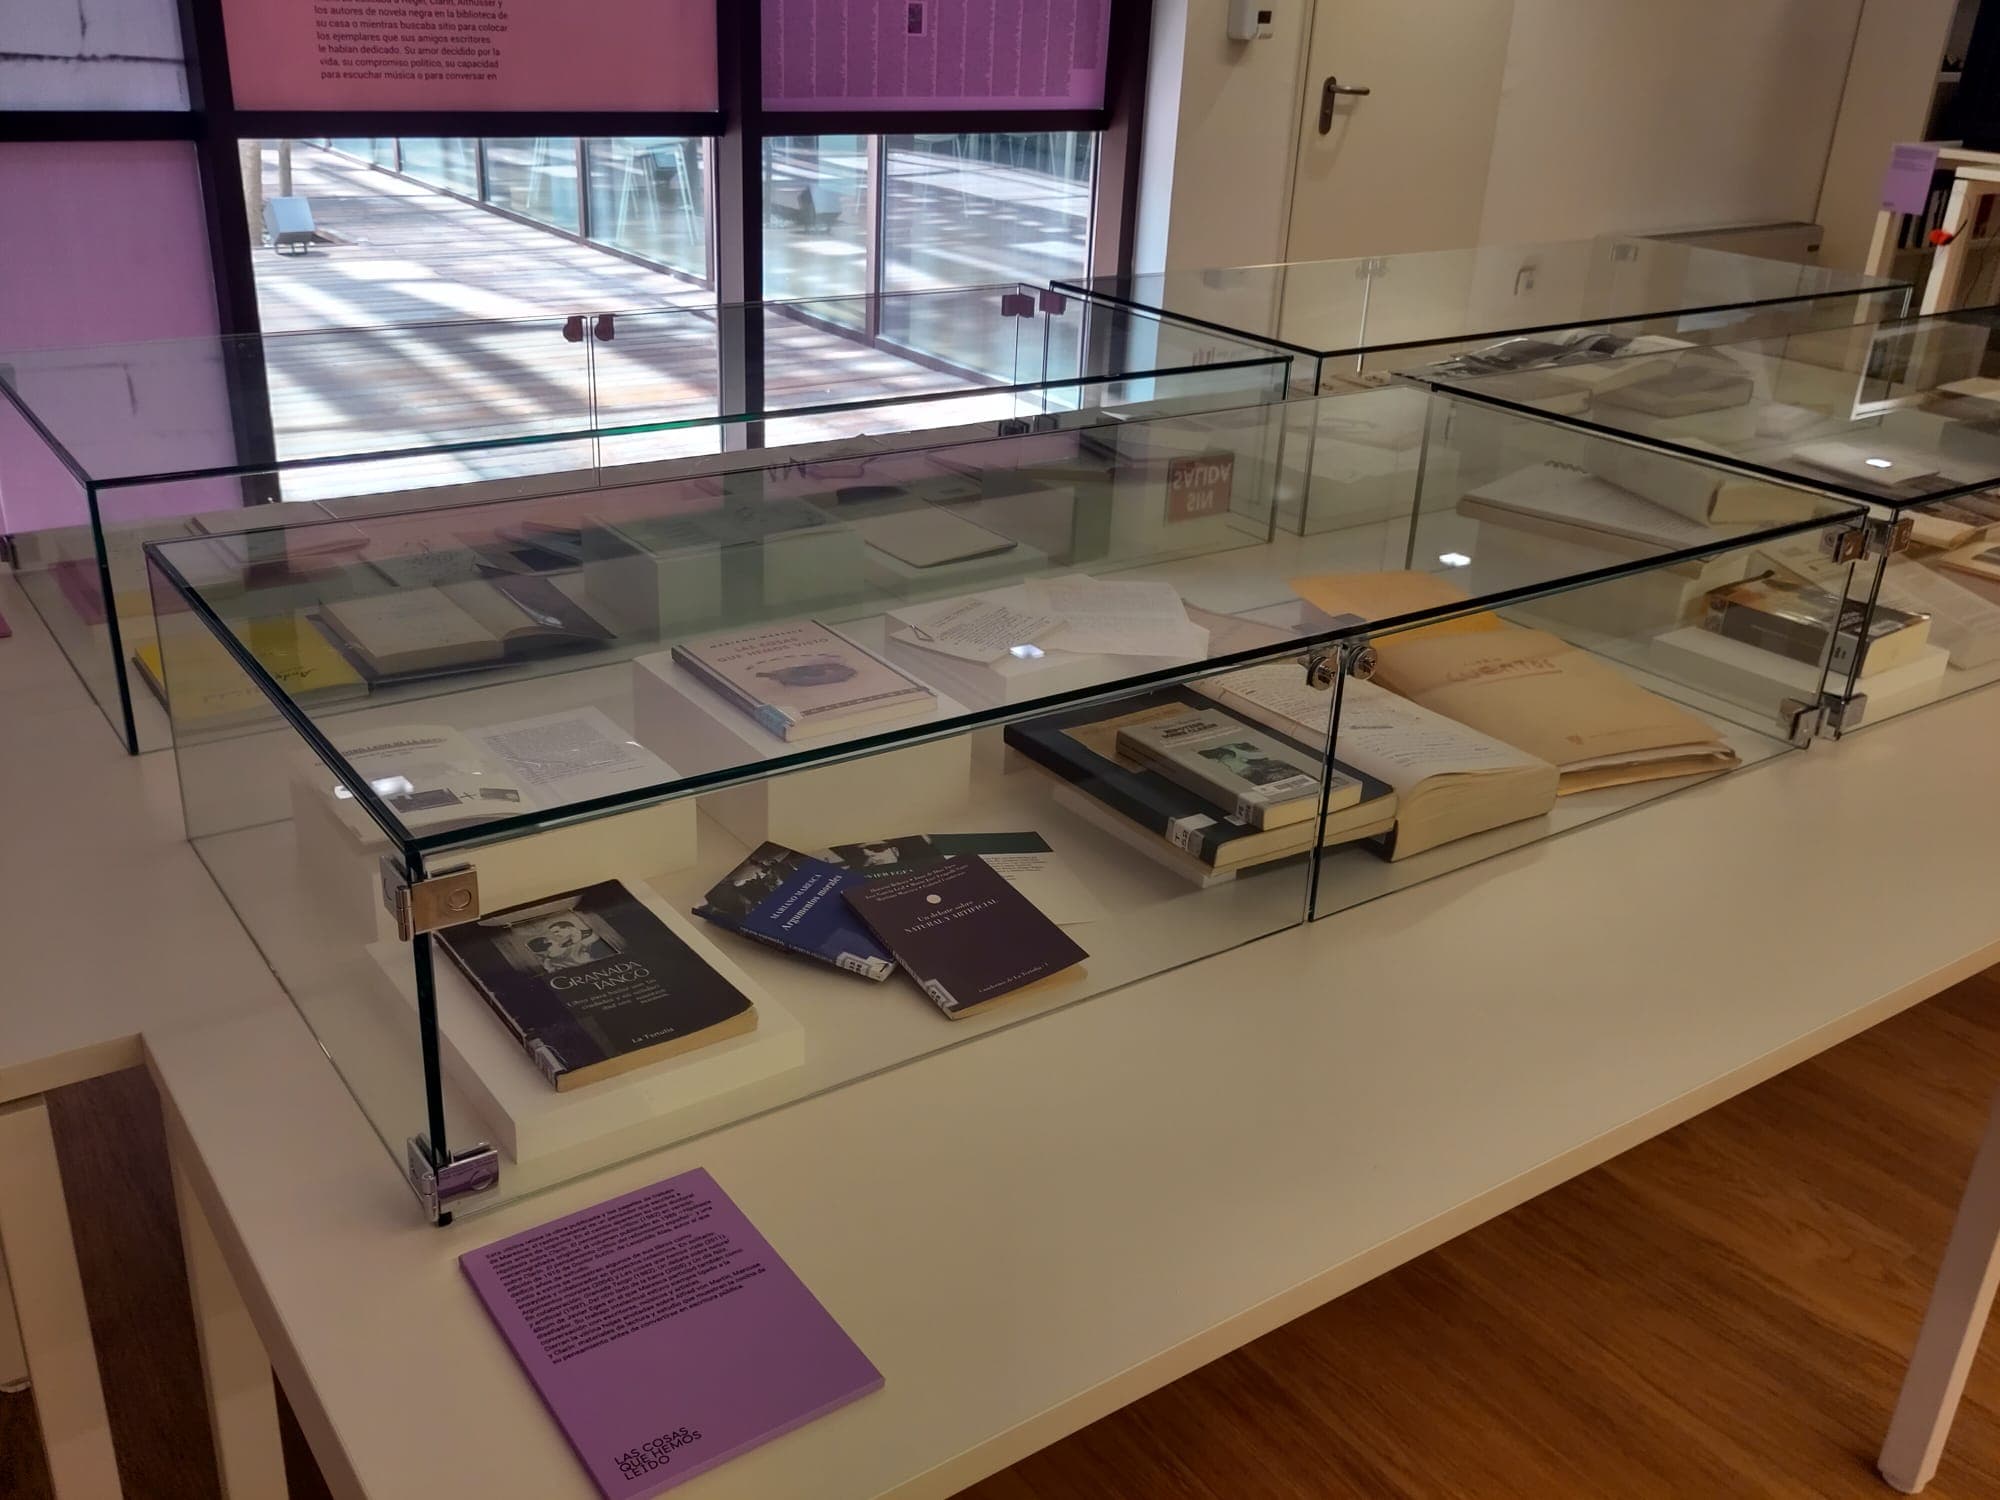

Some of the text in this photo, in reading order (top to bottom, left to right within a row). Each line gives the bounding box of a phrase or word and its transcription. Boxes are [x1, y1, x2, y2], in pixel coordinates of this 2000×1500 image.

[314, 6, 328, 14] los
[330, 7, 364, 16] autores
[365, 8, 376, 16] de
[378, 8, 406, 16] novela
[408, 10, 432, 19] negra
[446, 10, 454, 18] la
[456, 10, 496, 19] biblioteca
[498, 12, 508, 20] de
[360, 20, 398, 28] mientras
[400, 21, 436, 30] buscaba
[438, 22, 456, 30] sitio
[458, 24, 476, 32] para
[478, 24, 508, 32] colocar
[317, 32, 330, 40] los
[332, 32, 380, 42] ejemplares
[382, 34, 398, 42] que
[418, 35, 448, 44] amigos
[450, 35, 490, 44] escritores
[318, 44, 326, 52] le
[404, 46, 416, 54] Su
[441, 46, 476, 56] decidido
[478, 49, 490, 57] por
[355, 59, 408, 67] compromiso
[457, 60, 498, 68] capacidad
[321, 72, 340, 80] para
[343, 70, 382, 79] escuchar
[384, 70, 414, 79] música
[781, 896, 822, 931] Argumentos
[817, 875, 843, 898] morales
[614, 1427, 689, 1465] LAS COSAS
[620, 1430, 702, 1472] QUE HEMOS
